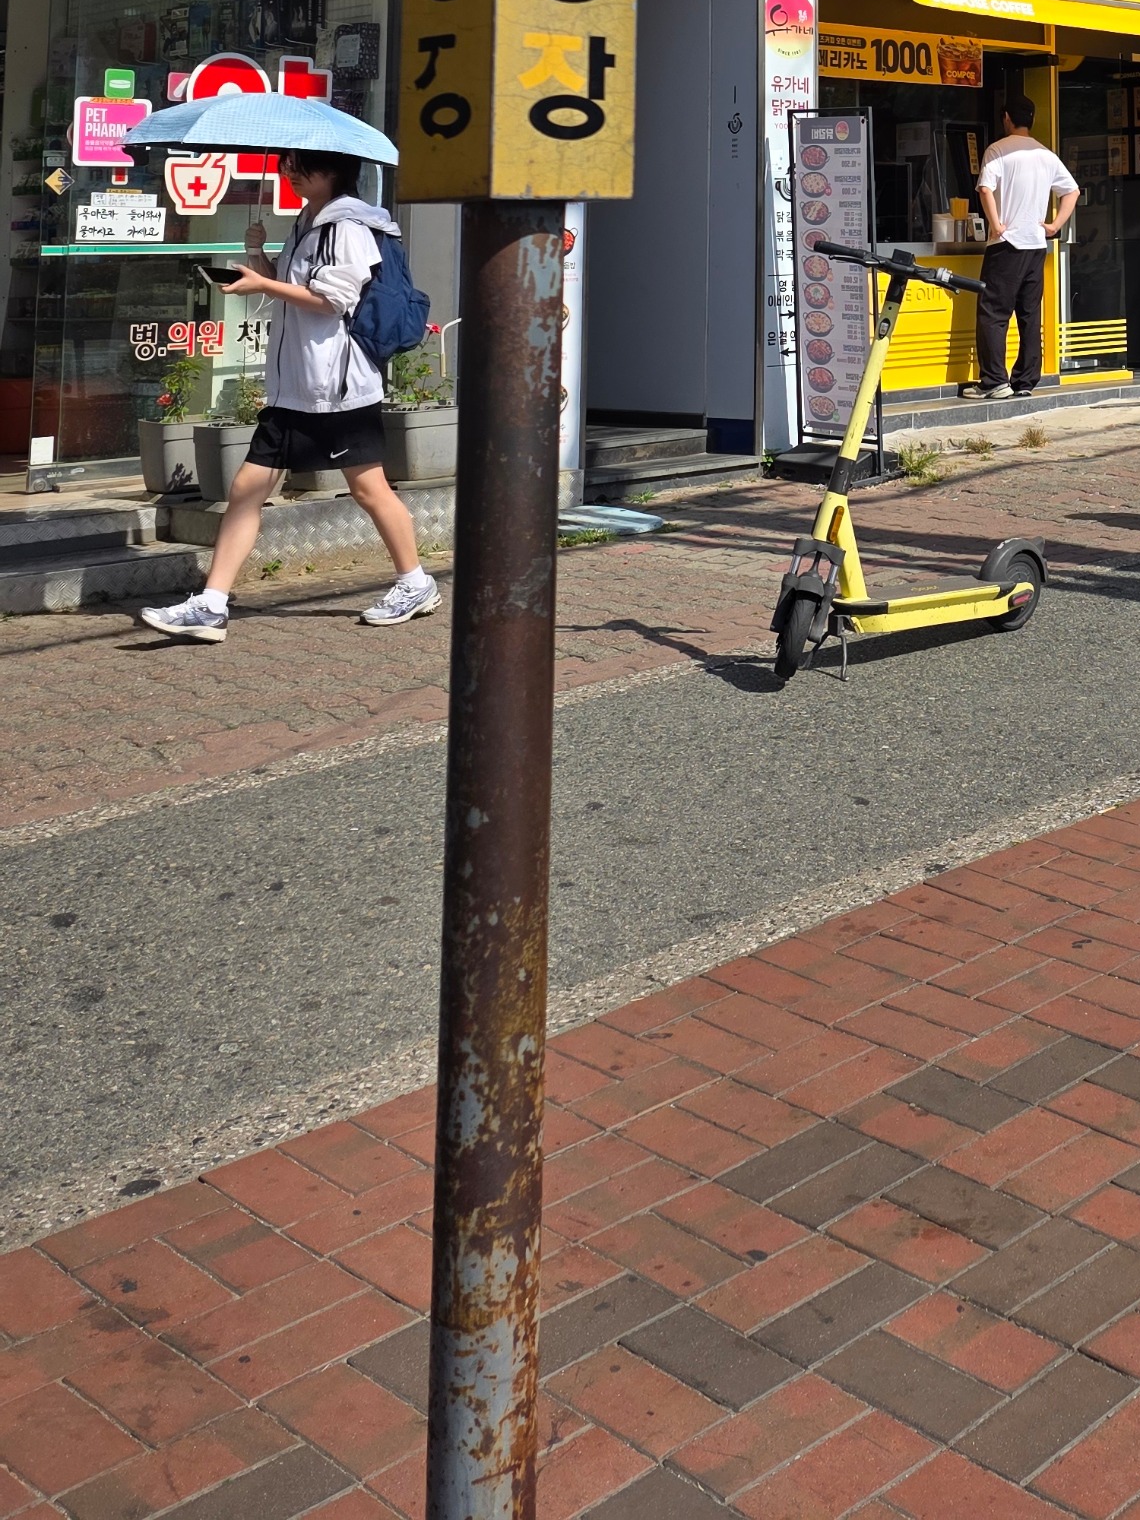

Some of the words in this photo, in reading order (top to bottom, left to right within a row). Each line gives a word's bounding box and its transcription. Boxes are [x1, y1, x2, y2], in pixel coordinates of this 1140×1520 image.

[770, 75, 810, 95] 유가네
[85, 107, 108, 123] PET
[126, 208, 162, 221] 들어와서
[79, 225, 116, 237] 물마시고
[126, 225, 159, 237] 가세요
[767, 294, 795, 307] 이비인
[916, 287, 942, 301] OUT
